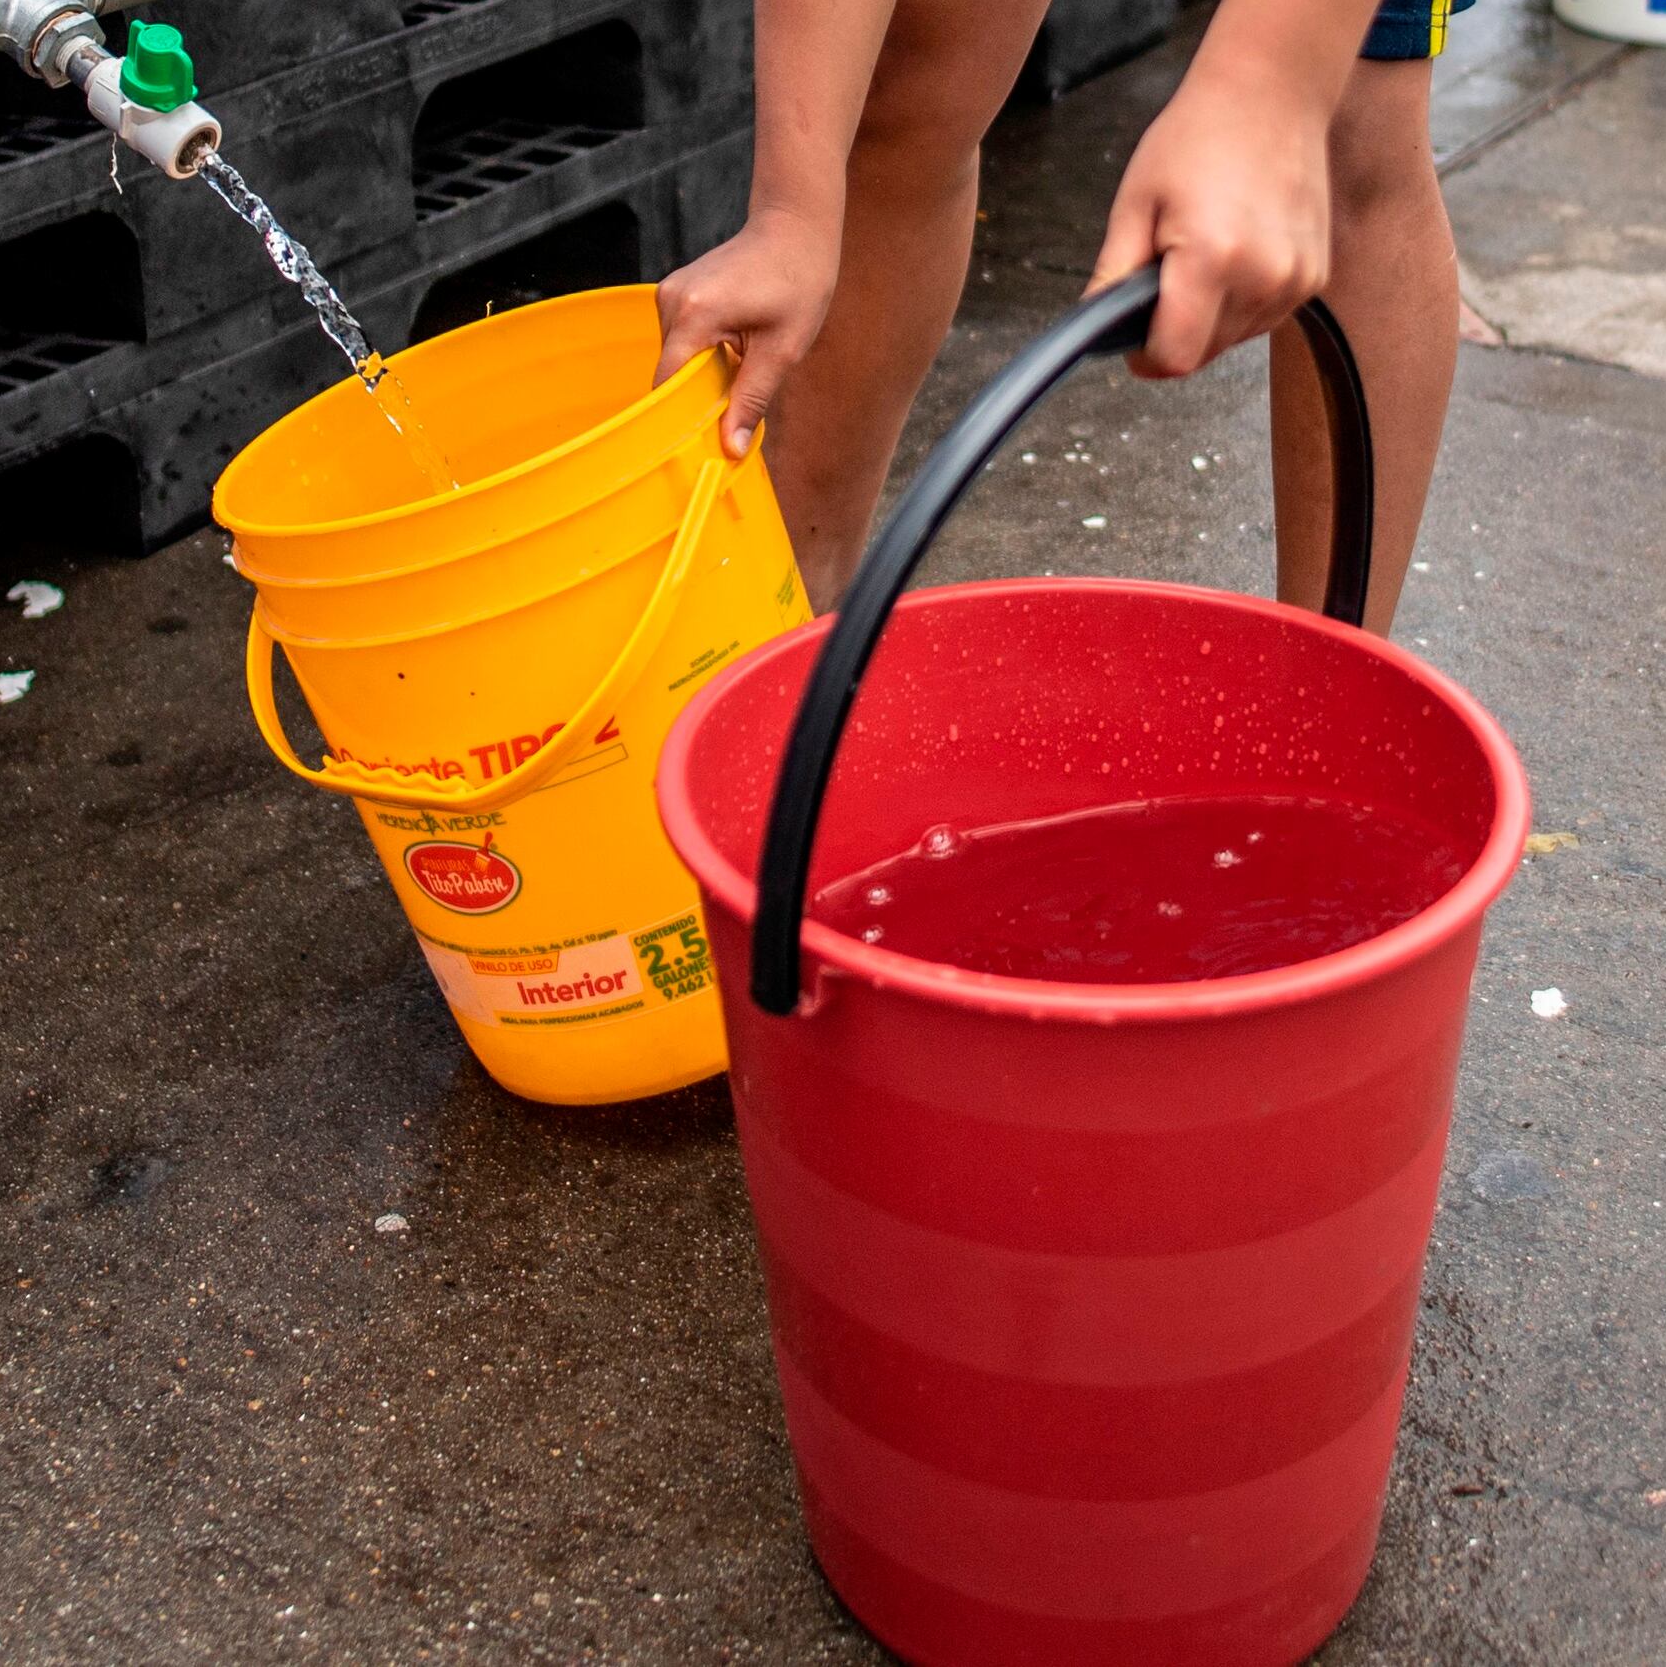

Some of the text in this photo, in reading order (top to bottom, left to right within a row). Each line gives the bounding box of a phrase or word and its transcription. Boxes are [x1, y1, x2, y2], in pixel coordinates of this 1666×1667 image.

[444, 811, 507, 832] VERDE
[633, 914, 697, 947] CONTENIDO
[470, 958, 554, 973] VINILO DE USO
[639, 926, 708, 977] 2.5
[516, 969, 628, 1006] Interior
[653, 956, 711, 989] GALONE
[662, 974, 707, 1001] 9.462
[597, 999, 645, 1019] ACABADOS
